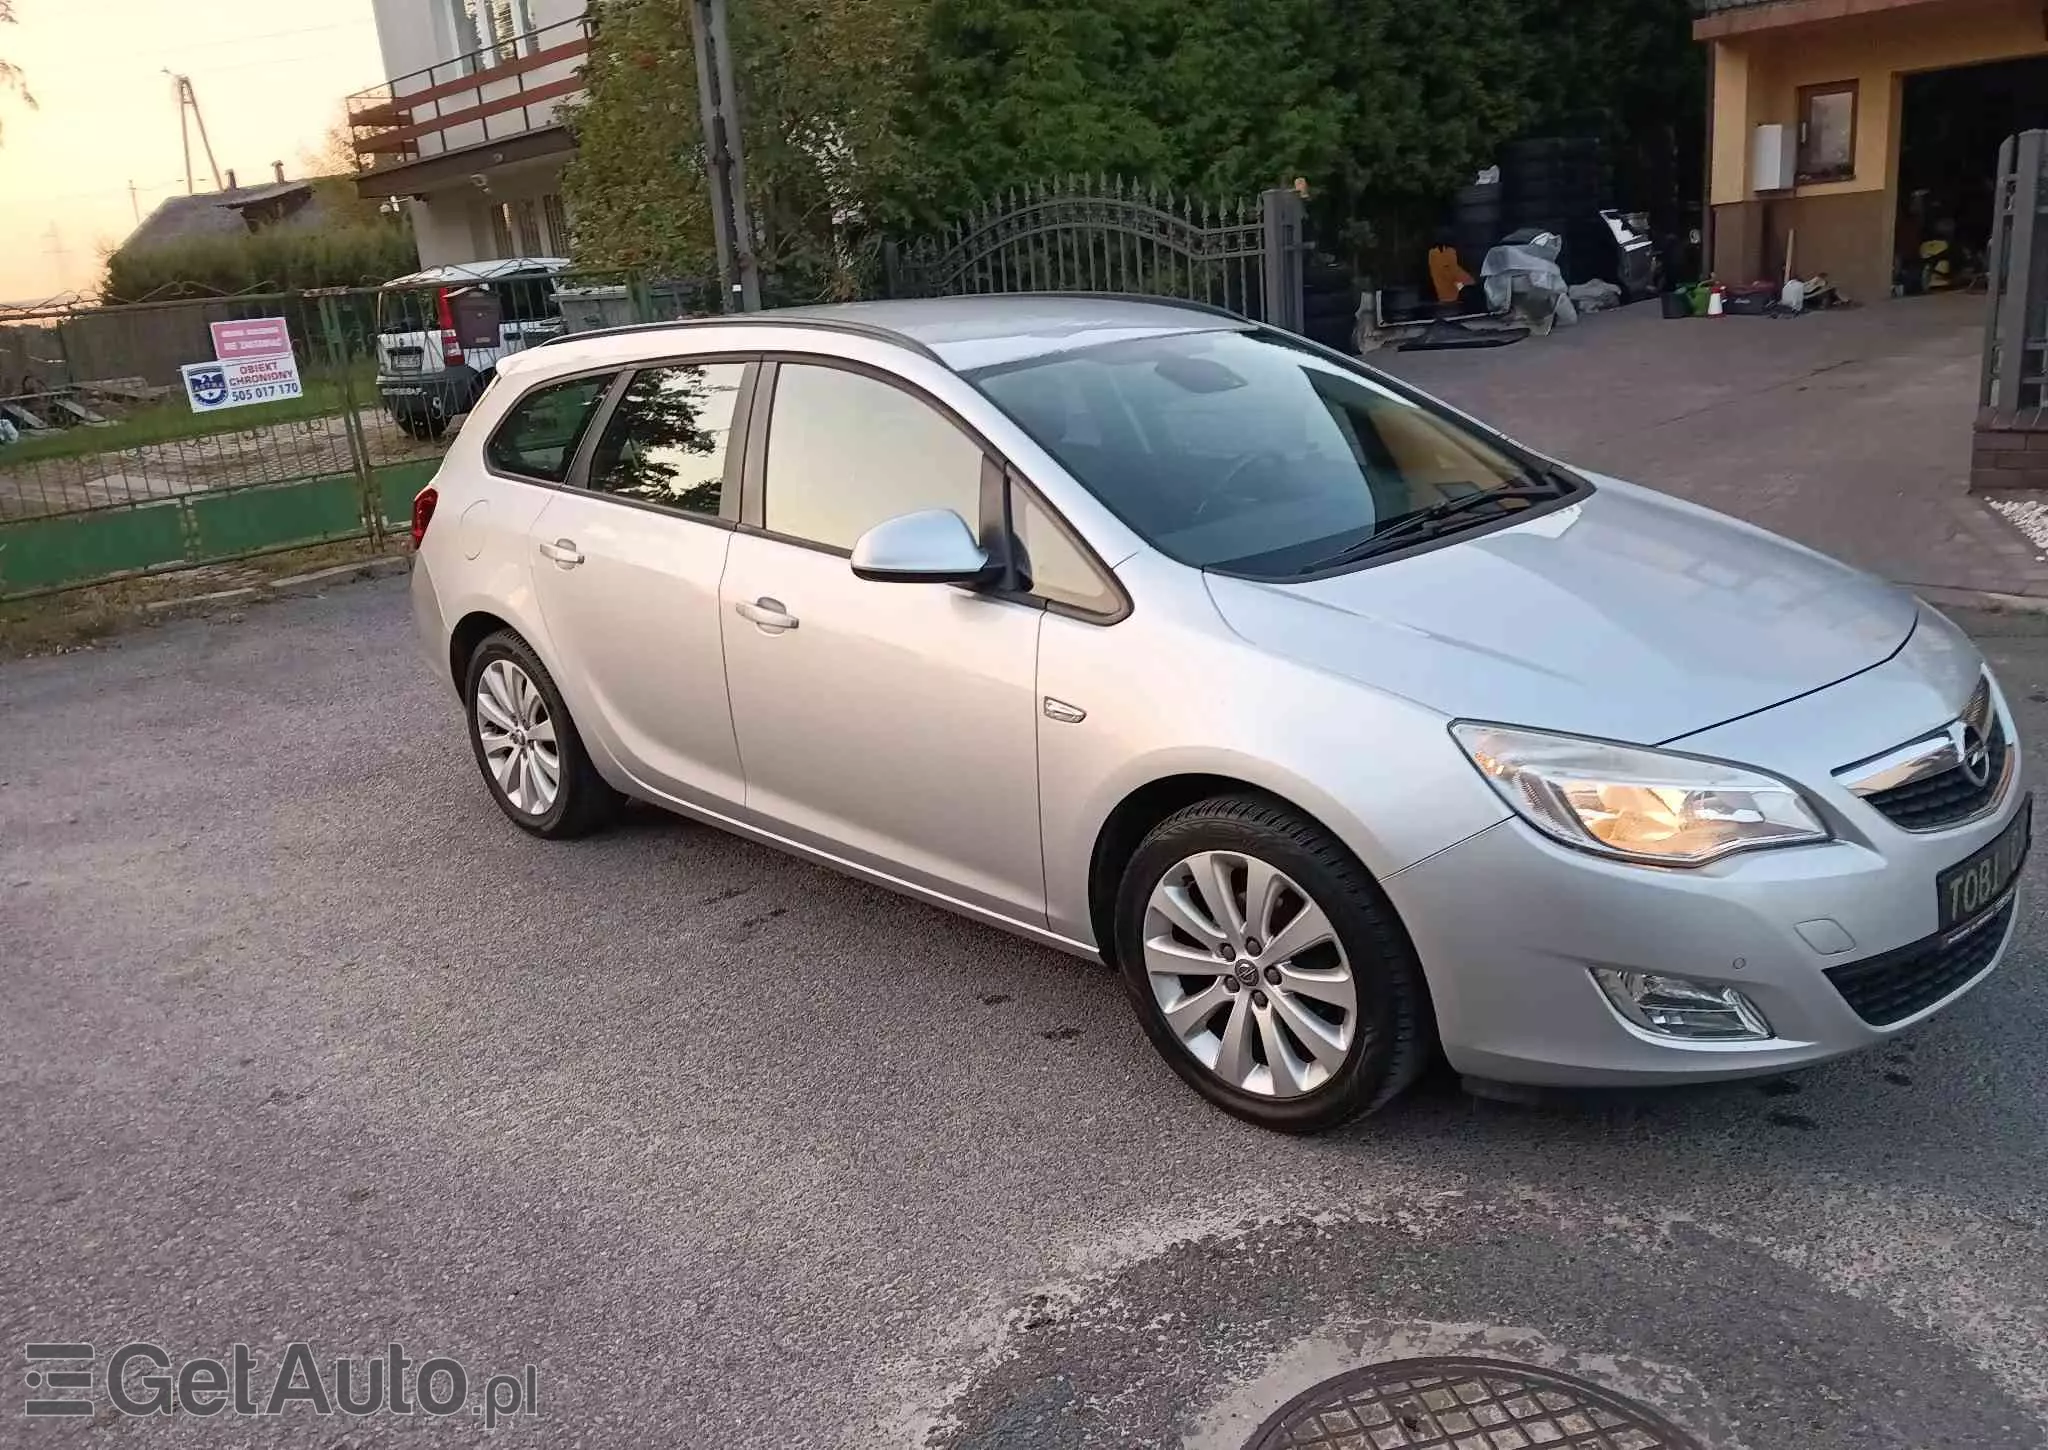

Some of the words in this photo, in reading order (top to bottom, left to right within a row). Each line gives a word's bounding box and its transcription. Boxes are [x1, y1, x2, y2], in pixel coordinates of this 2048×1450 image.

[239, 362, 278, 375] OBIEKT
[229, 370, 293, 387] CHRONIONY
[231, 389, 253, 401] 505
[255, 386, 275, 398] 017
[278, 382, 298, 394] 170
